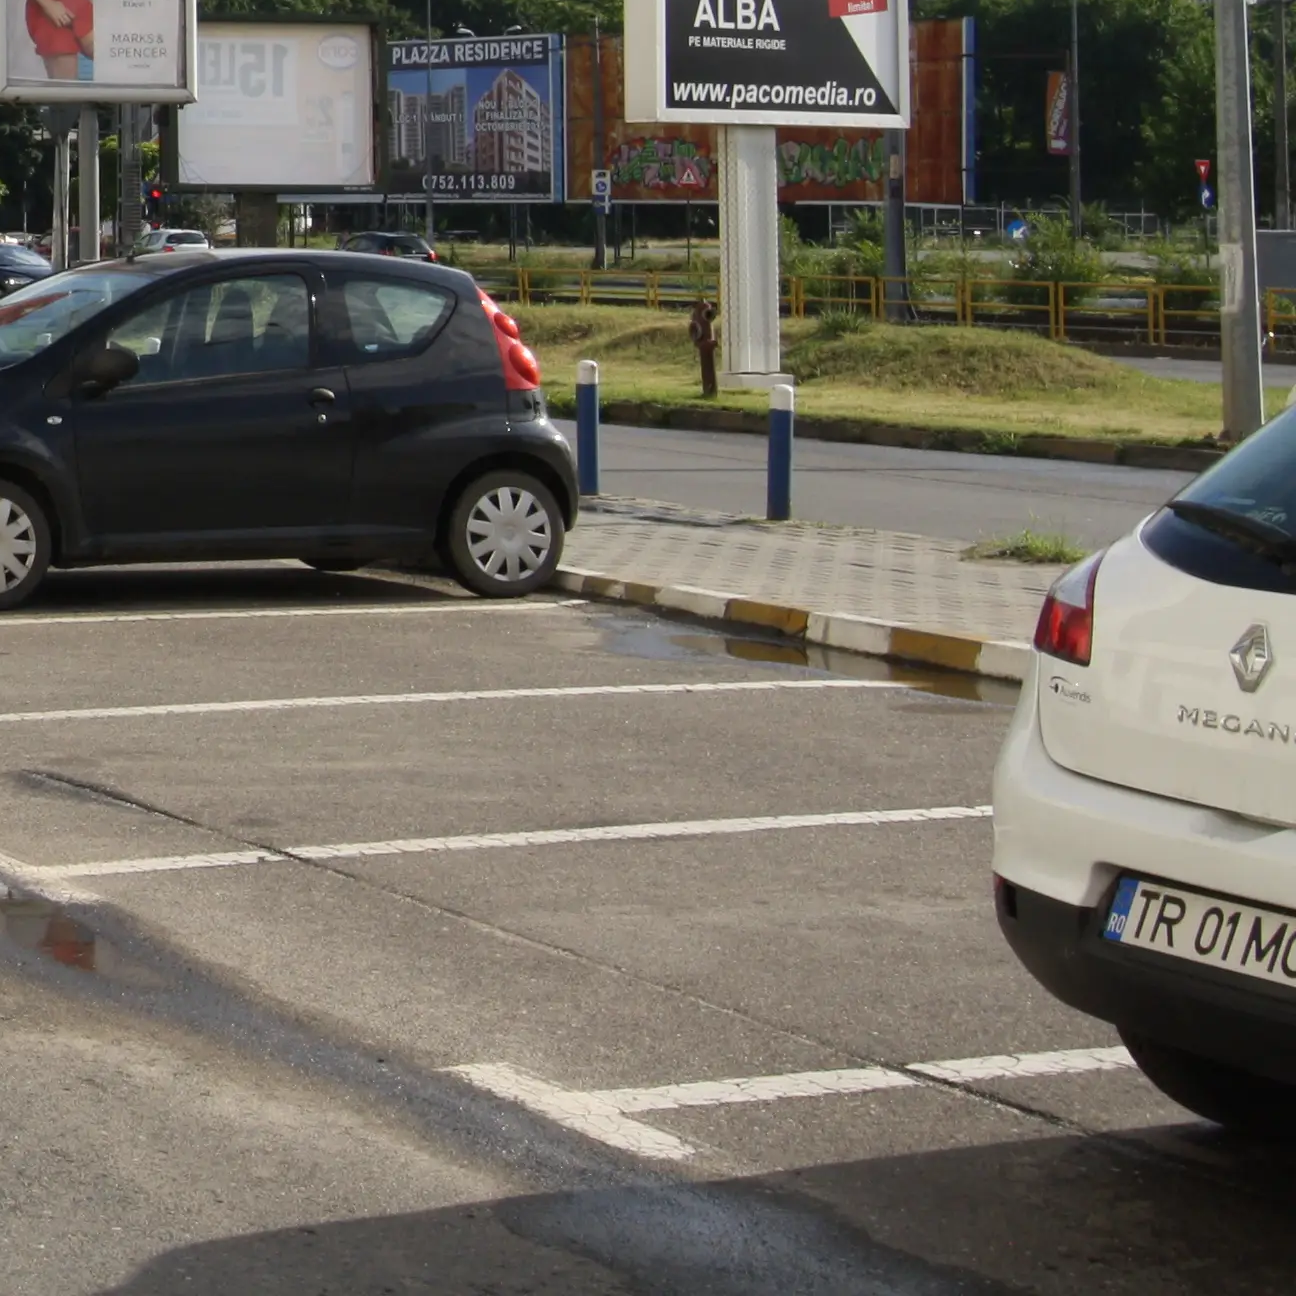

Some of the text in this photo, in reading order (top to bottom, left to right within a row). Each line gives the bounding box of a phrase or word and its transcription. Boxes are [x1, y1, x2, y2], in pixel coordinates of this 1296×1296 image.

[112, 34, 154, 44] MARKS
[688, 36, 786, 50] PE MATERIALE RIGIDE
[109, 47, 167, 58] SPENCER
[392, 40, 543, 65] PLAZZA RESIDENCE
[673, 81, 876, 109] www.pacomedia.ro
[422, 175, 516, 190] 0752.113.809
[1177, 704, 1296, 744] MEGAN
[1107, 912, 1126, 934] RO
[1134, 889, 1187, 948] TR
[1194, 906, 1242, 961] 01
